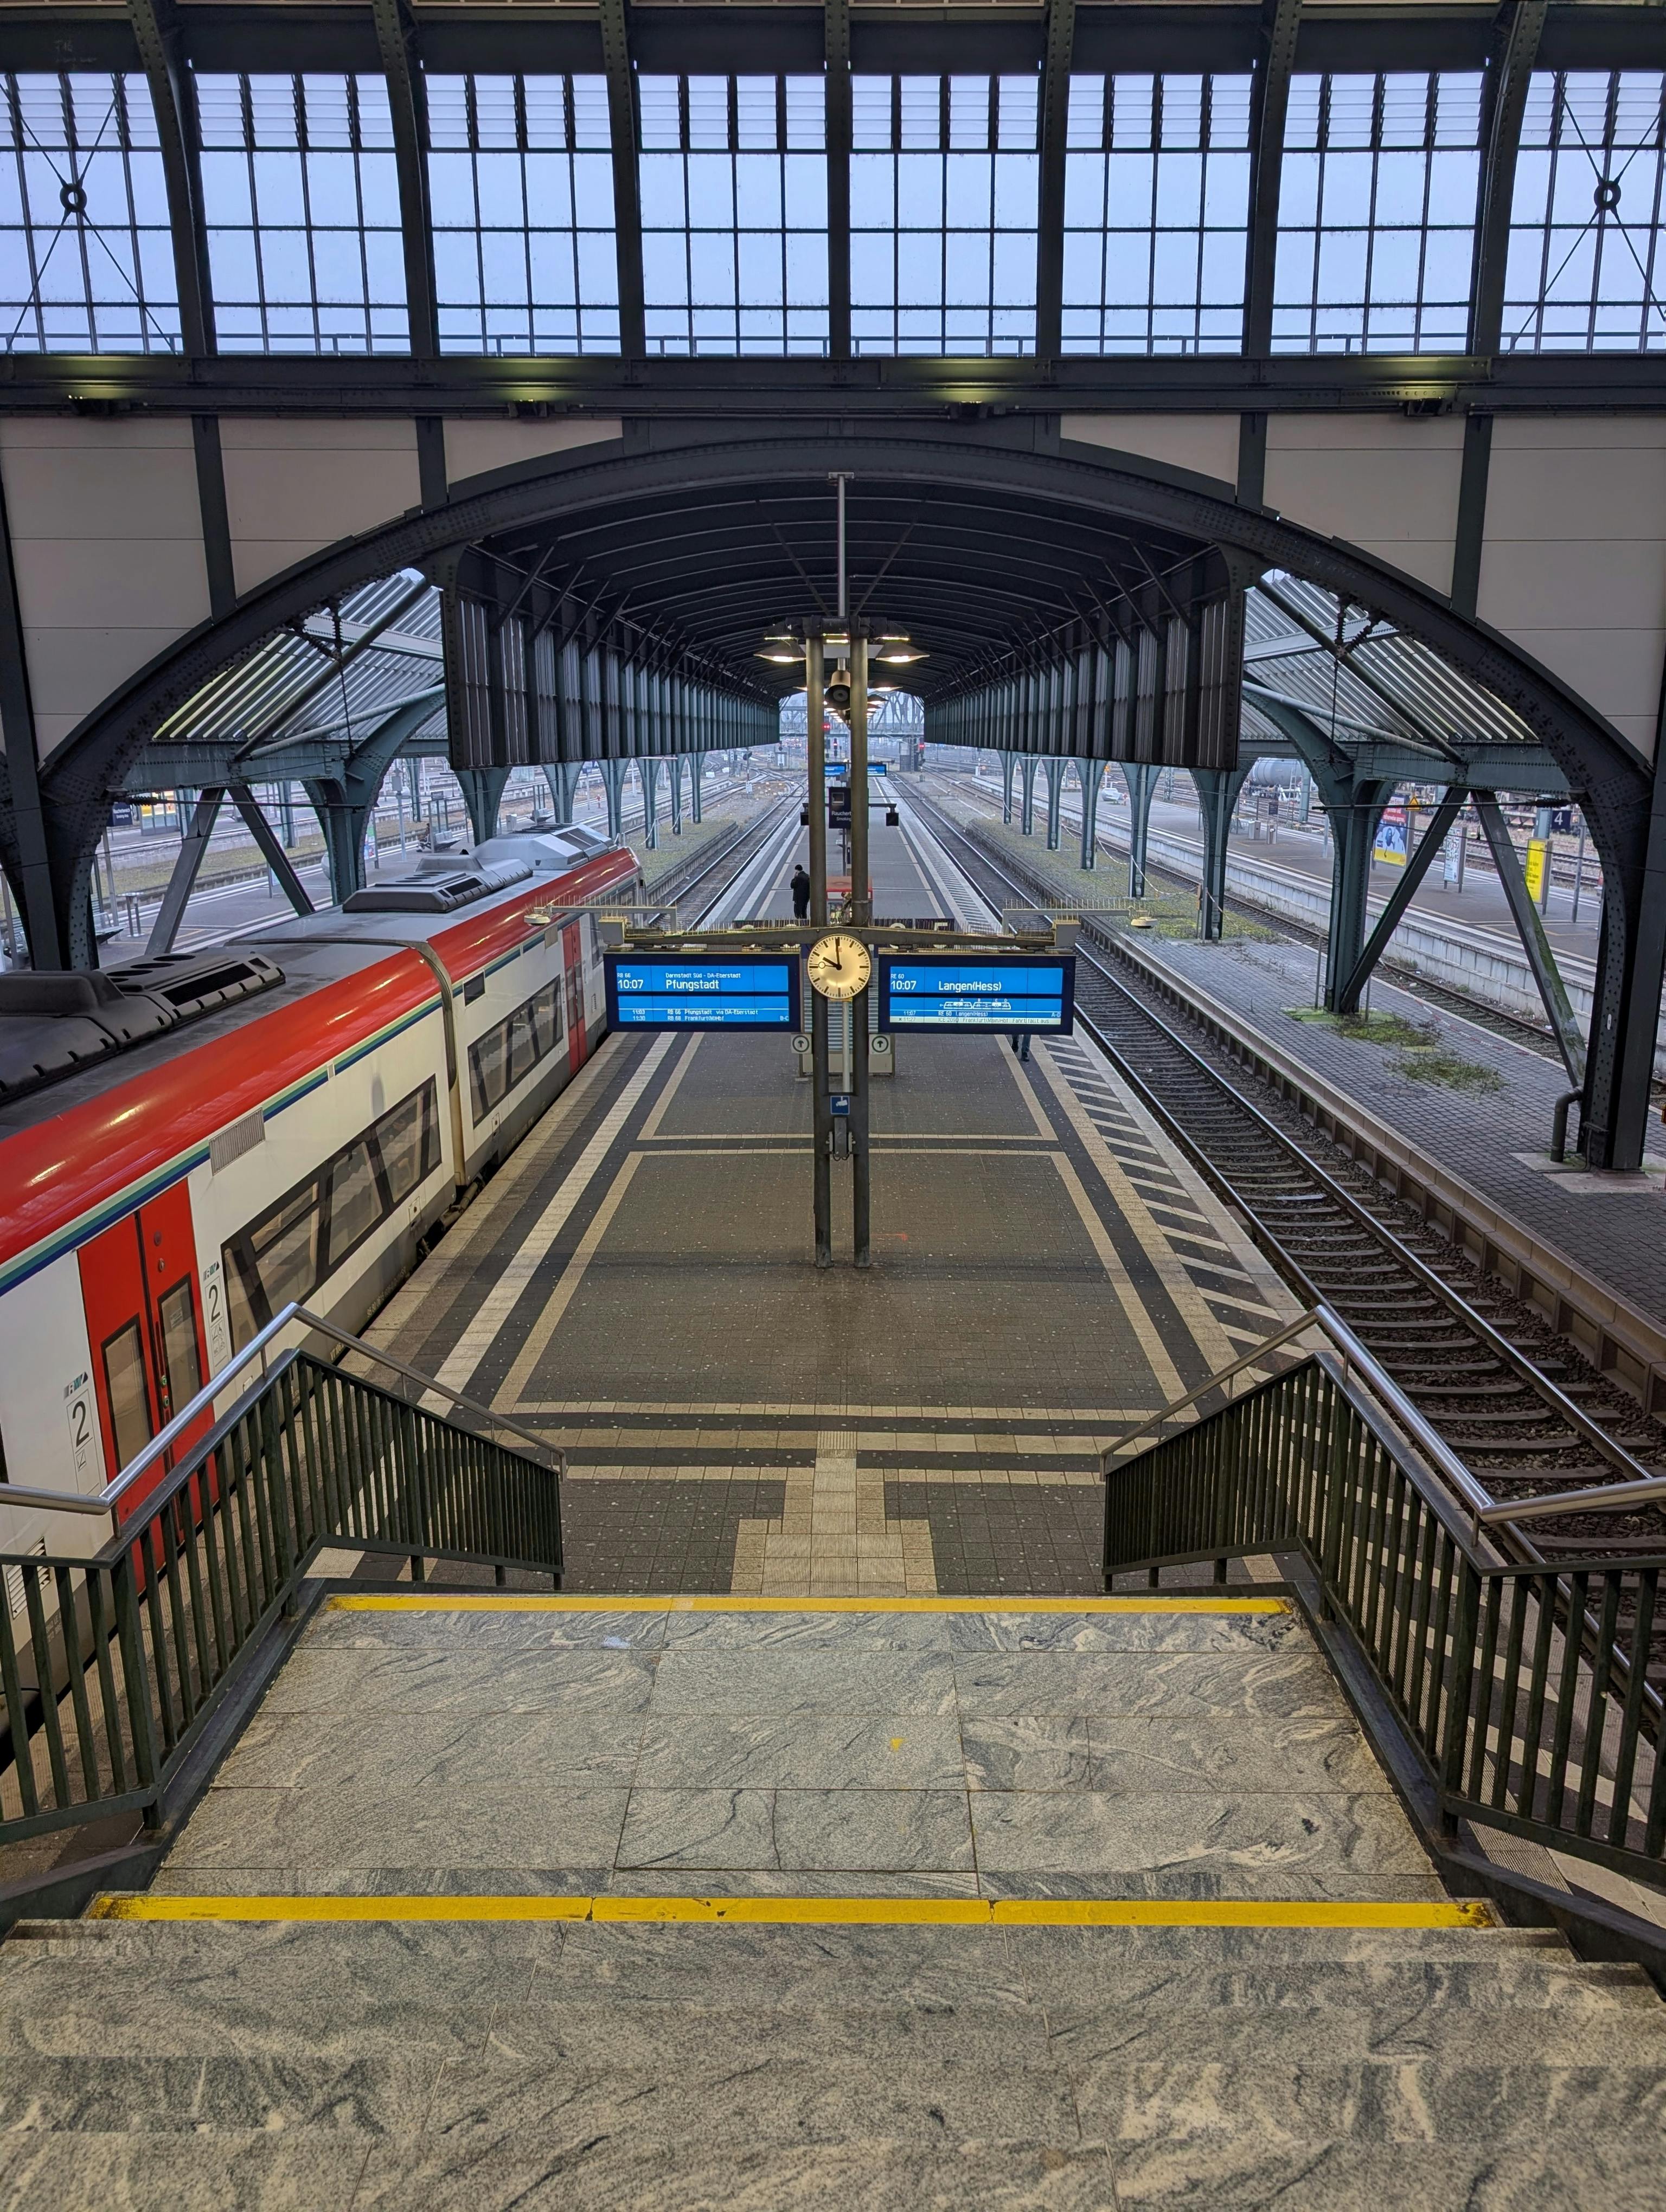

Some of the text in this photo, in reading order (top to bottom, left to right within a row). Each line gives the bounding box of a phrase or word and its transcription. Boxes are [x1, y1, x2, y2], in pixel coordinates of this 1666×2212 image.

[1554, 812, 1563, 825] 4
[617, 979, 644, 989] 10:07
[666, 980, 719, 991] Pfungstadt
[891, 980, 917, 990] 10:07
[939, 981, 1001, 993] Langen(Hess)
[209, 1284, 220, 1323] 2
[73, 1401, 89, 1448] 2
